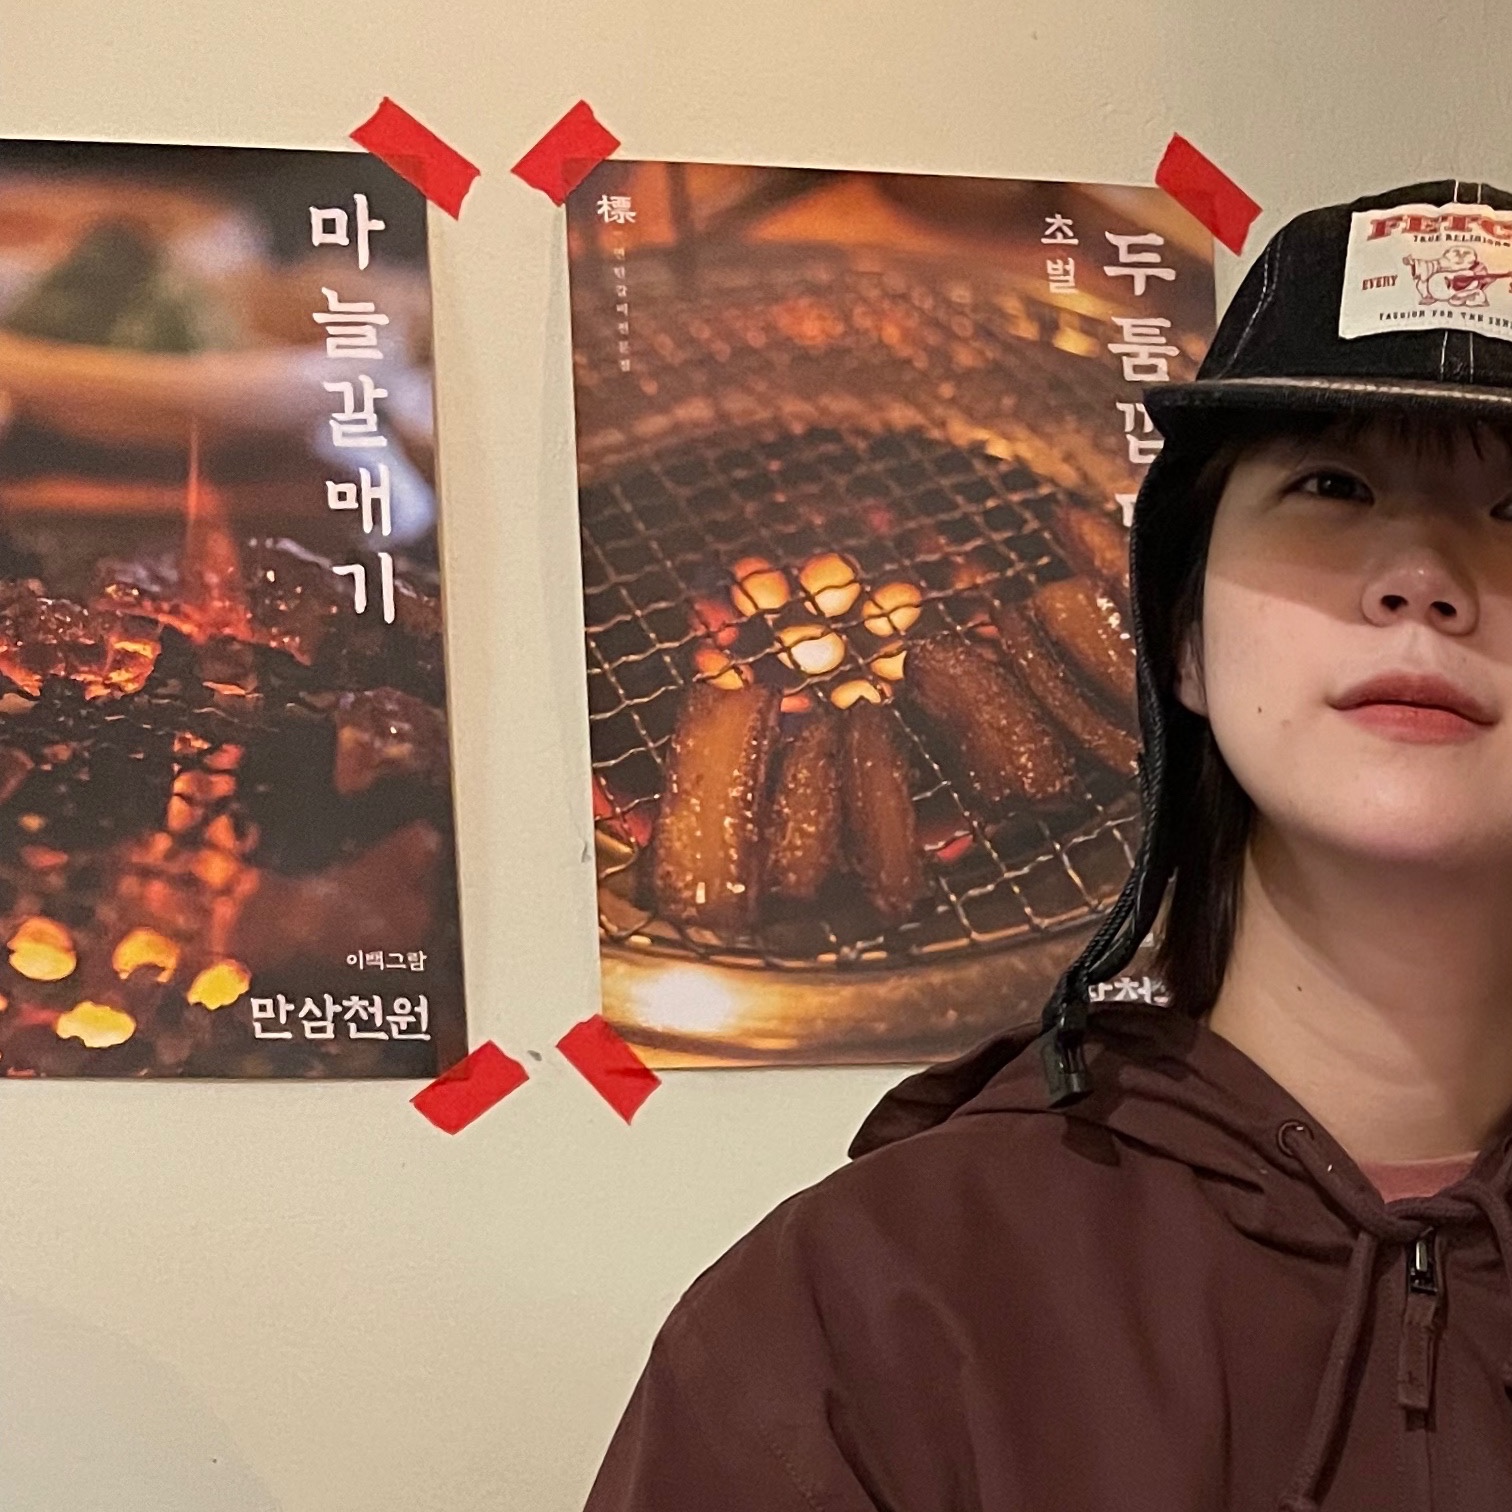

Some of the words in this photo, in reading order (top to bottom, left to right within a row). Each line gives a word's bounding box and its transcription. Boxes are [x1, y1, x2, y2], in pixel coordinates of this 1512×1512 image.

[1413, 234, 1441, 244] TRUE
[1041, 213, 1080, 295] 초벌
[1362, 275, 1398, 291] EVERY
[1379, 310, 1425, 321] FASHION
[1432, 310, 1453, 318] FOR
[1460, 312, 1484, 322] THE
[308, 193, 396, 624] 마늘갈매기
[346, 950, 427, 972] 이백그람
[250, 993, 432, 1041] 만삼천원
